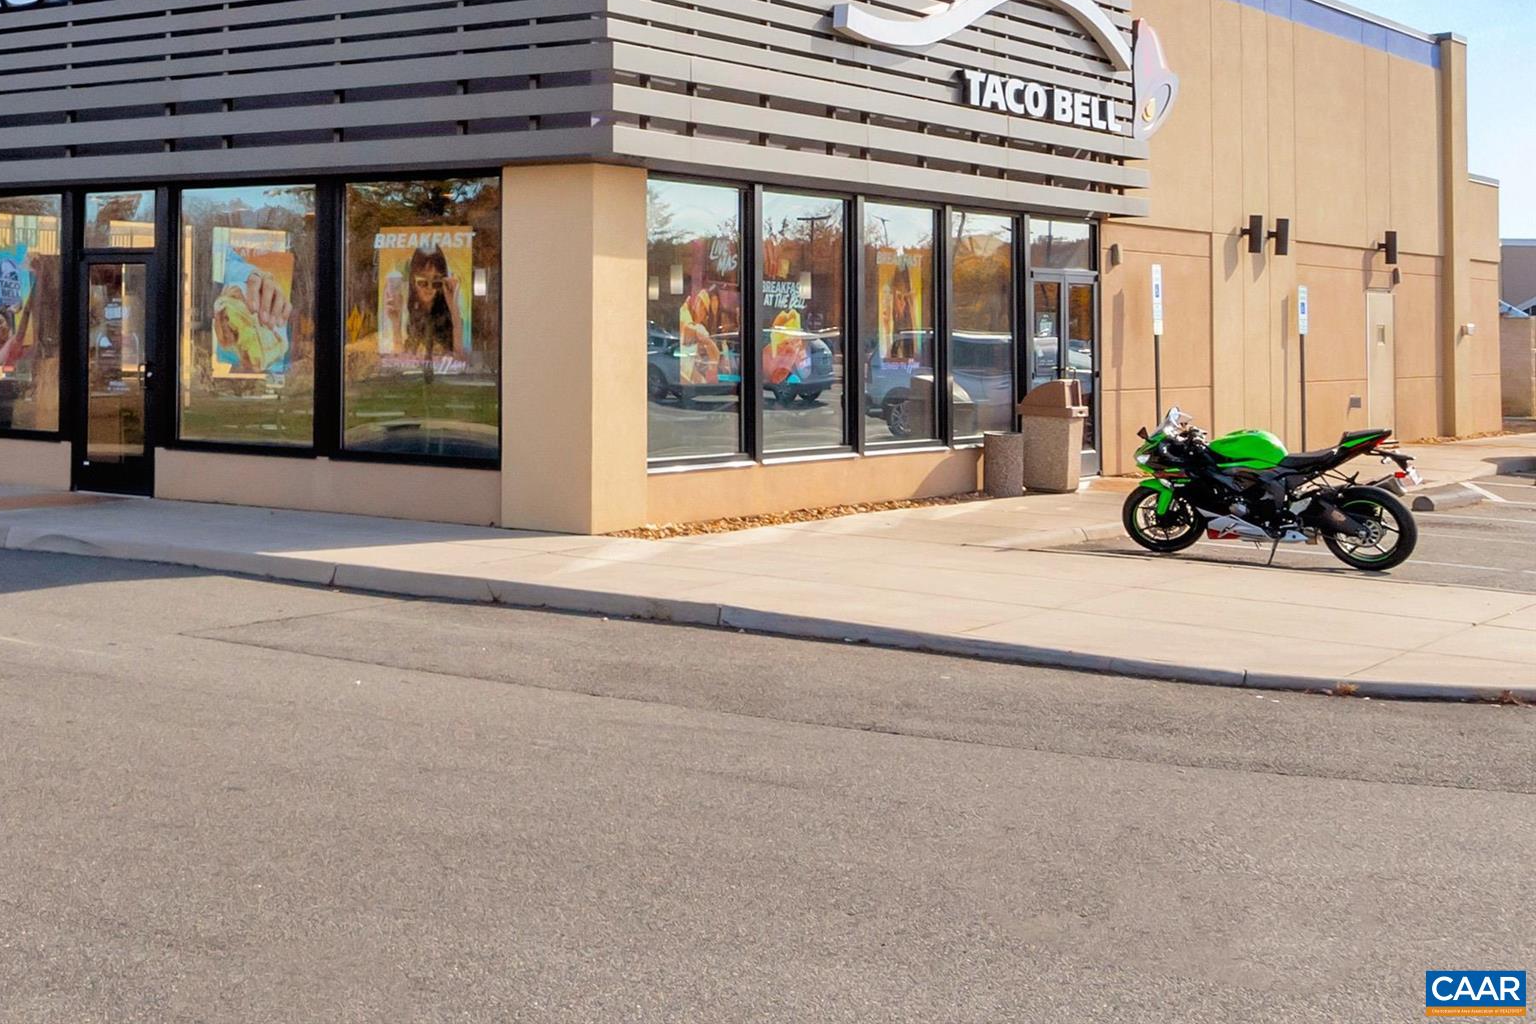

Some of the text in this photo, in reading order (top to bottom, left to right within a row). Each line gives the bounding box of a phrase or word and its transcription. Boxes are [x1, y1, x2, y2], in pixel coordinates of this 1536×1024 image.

[965, 68, 1122, 132] TACO BELL
[373, 231, 477, 249] BREAKFAST
[0, 279, 21, 289] TACO
[762, 280, 801, 294] BREAKFAS
[1, 288, 20, 298] BELL
